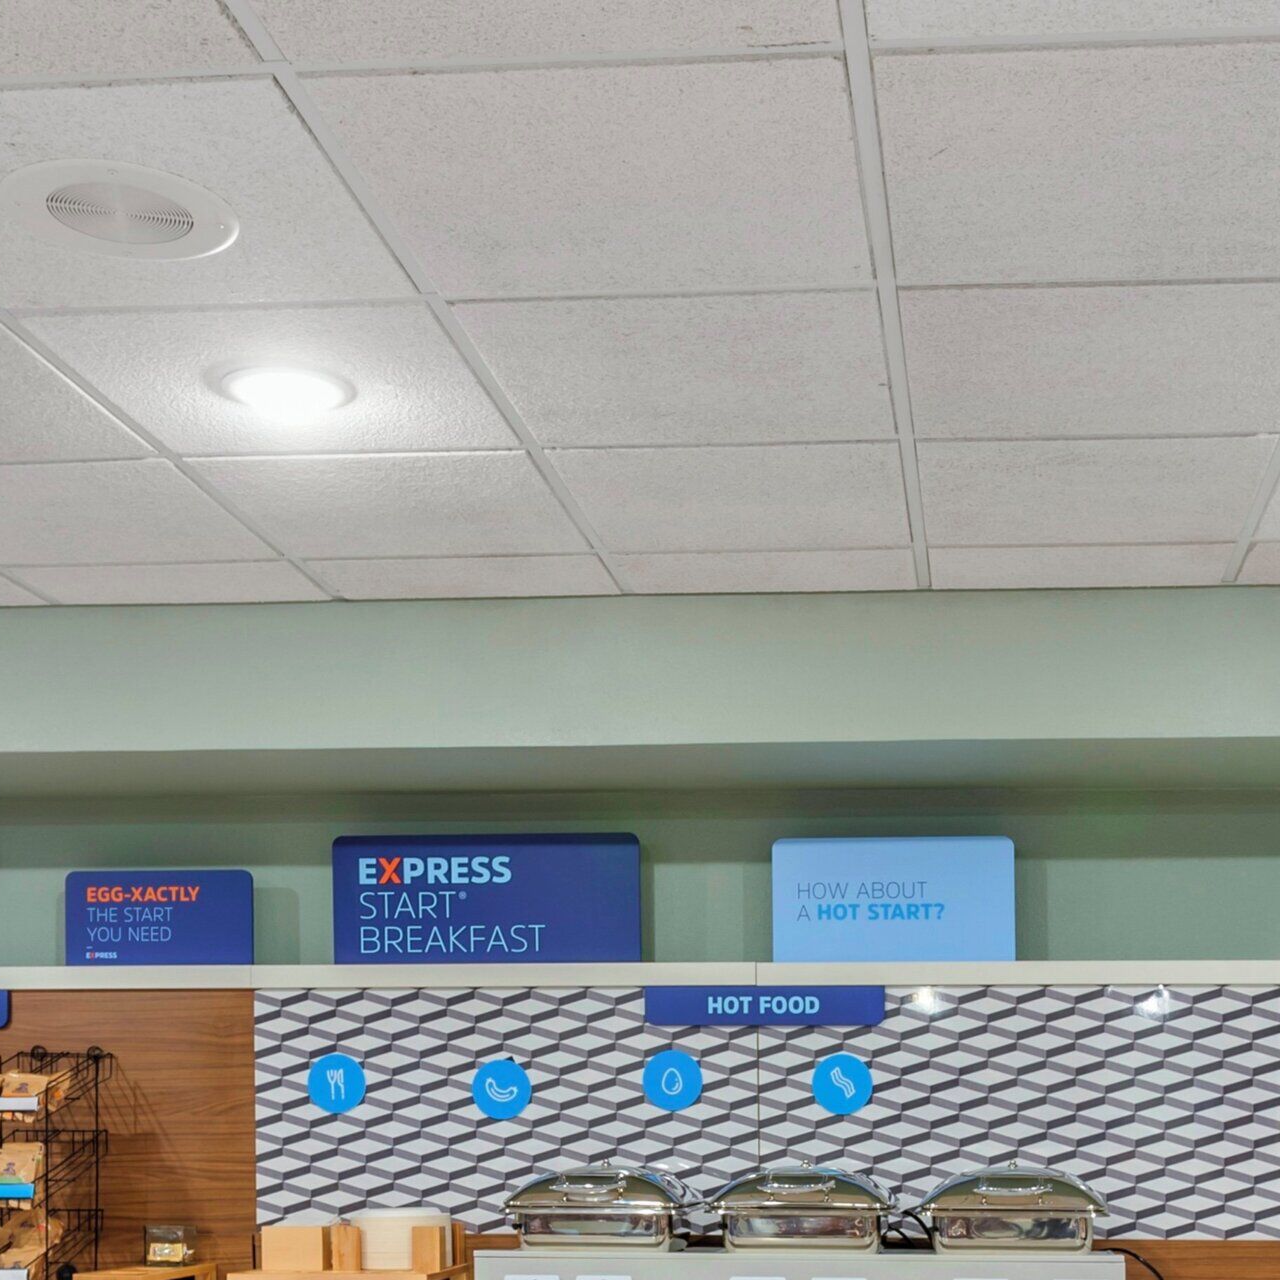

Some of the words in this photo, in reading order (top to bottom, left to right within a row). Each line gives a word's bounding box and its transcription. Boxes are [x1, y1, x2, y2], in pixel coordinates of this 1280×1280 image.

[358, 856, 512, 885] EXPRESS
[86, 885, 200, 903] EGG-XACTLY
[797, 882, 849, 900] HOW
[856, 881, 928, 900] ABOUT
[86, 907, 118, 923] THE
[123, 906, 173, 923] START
[796, 904, 812, 922] A
[817, 903, 860, 921] HOT
[868, 902, 945, 921] START?
[86, 926, 121, 942] YOU
[128, 926, 172, 942] NEED
[360, 924, 546, 954] BREAKFAST
[707, 996, 753, 1015] HOT
[759, 996, 820, 1015] FOOD
